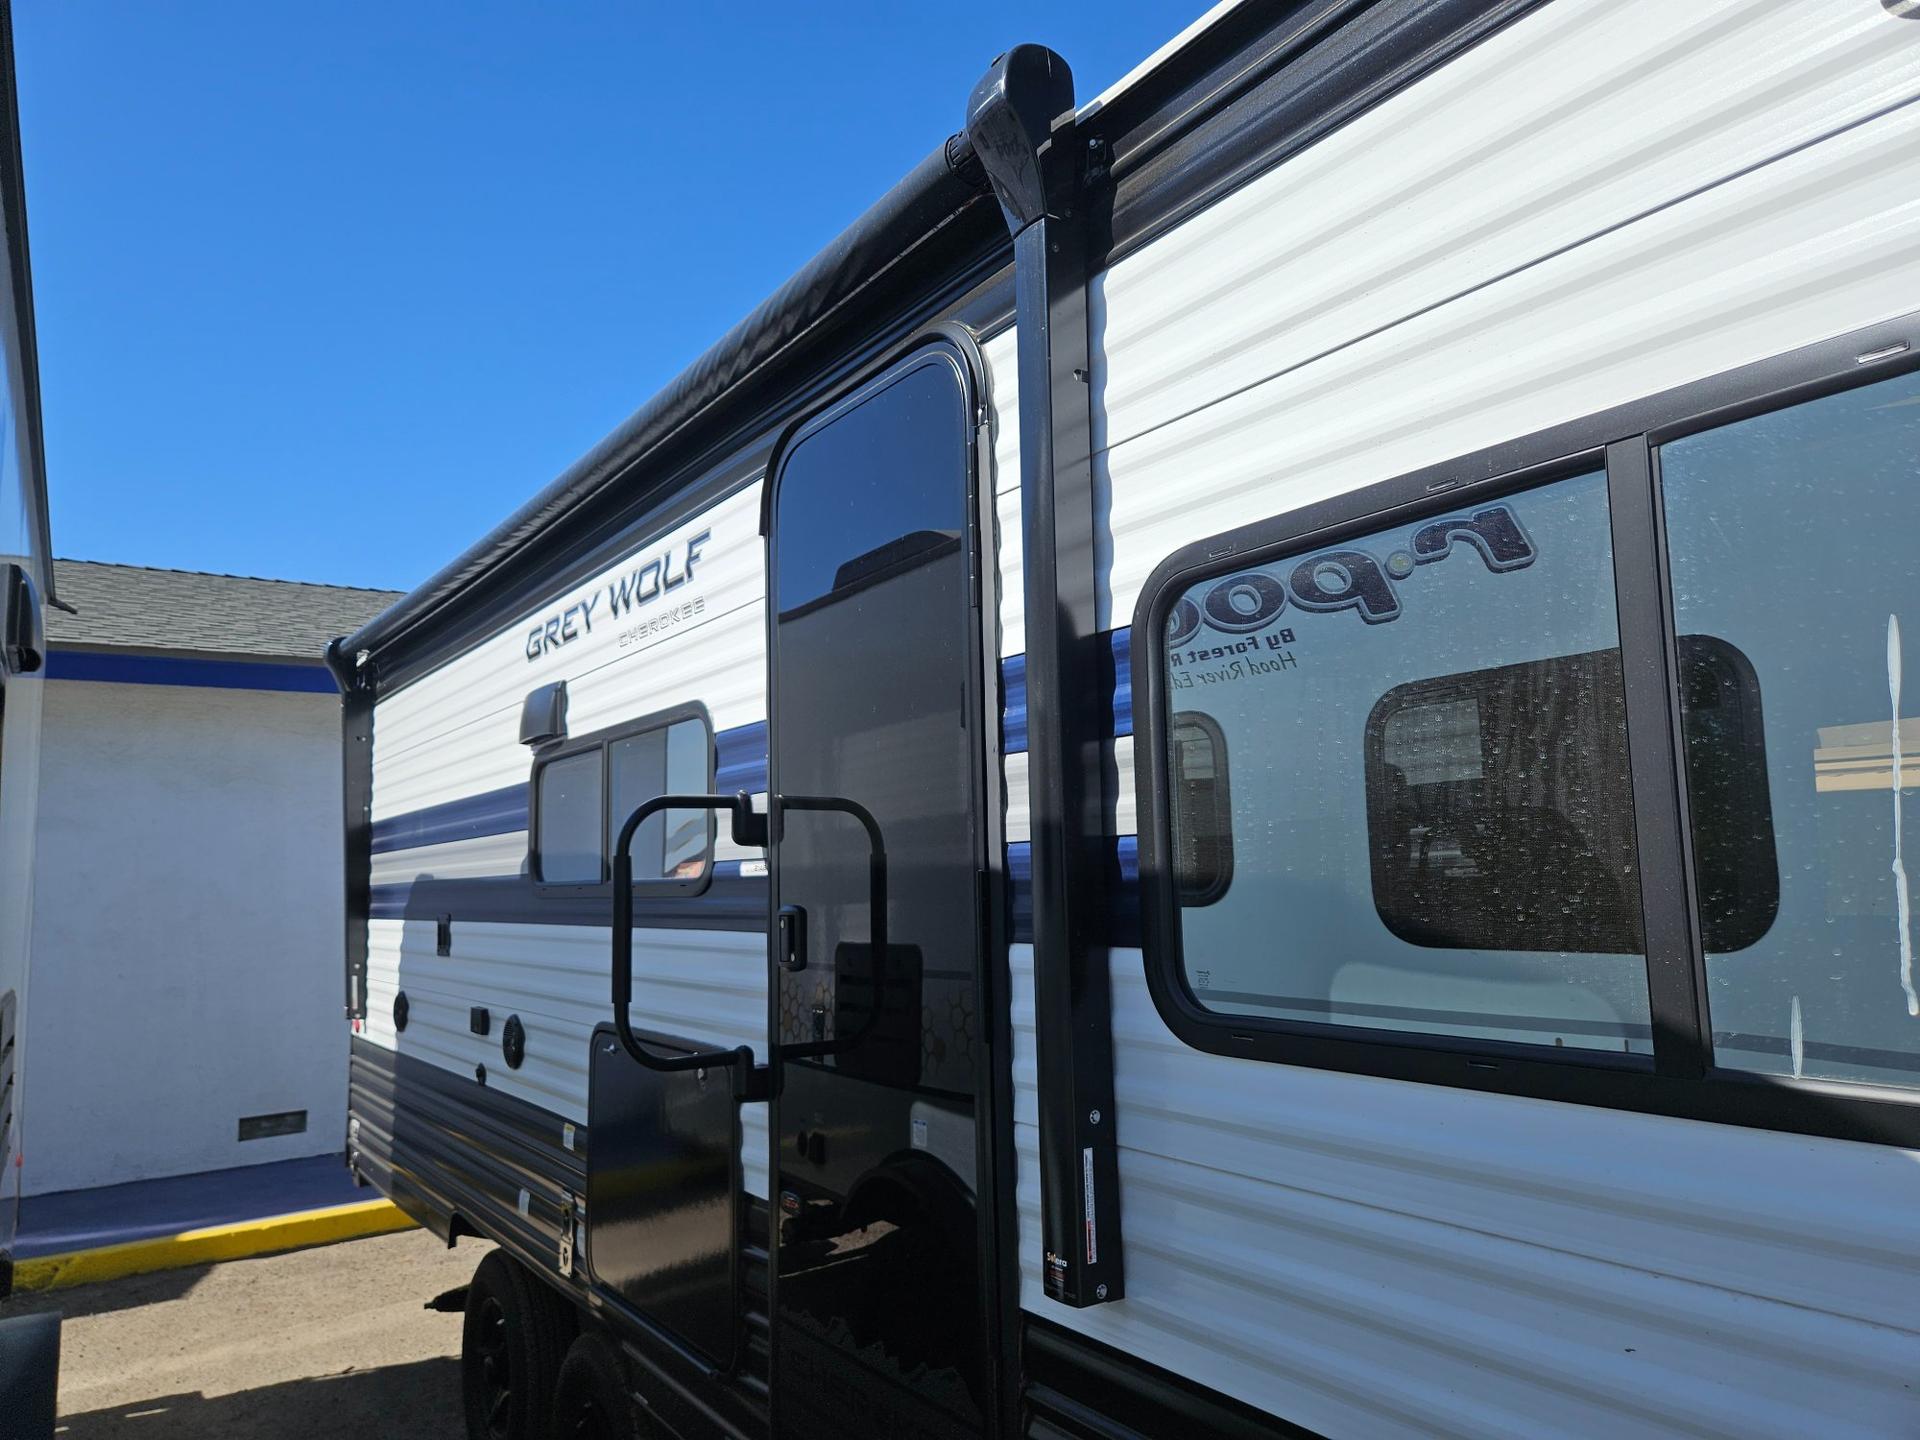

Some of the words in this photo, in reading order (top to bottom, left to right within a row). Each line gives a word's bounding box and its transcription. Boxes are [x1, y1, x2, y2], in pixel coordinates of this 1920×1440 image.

[525, 592, 600, 663] GREY
[609, 527, 711, 620] WOLF
[618, 596, 705, 647] CHEROKEE
